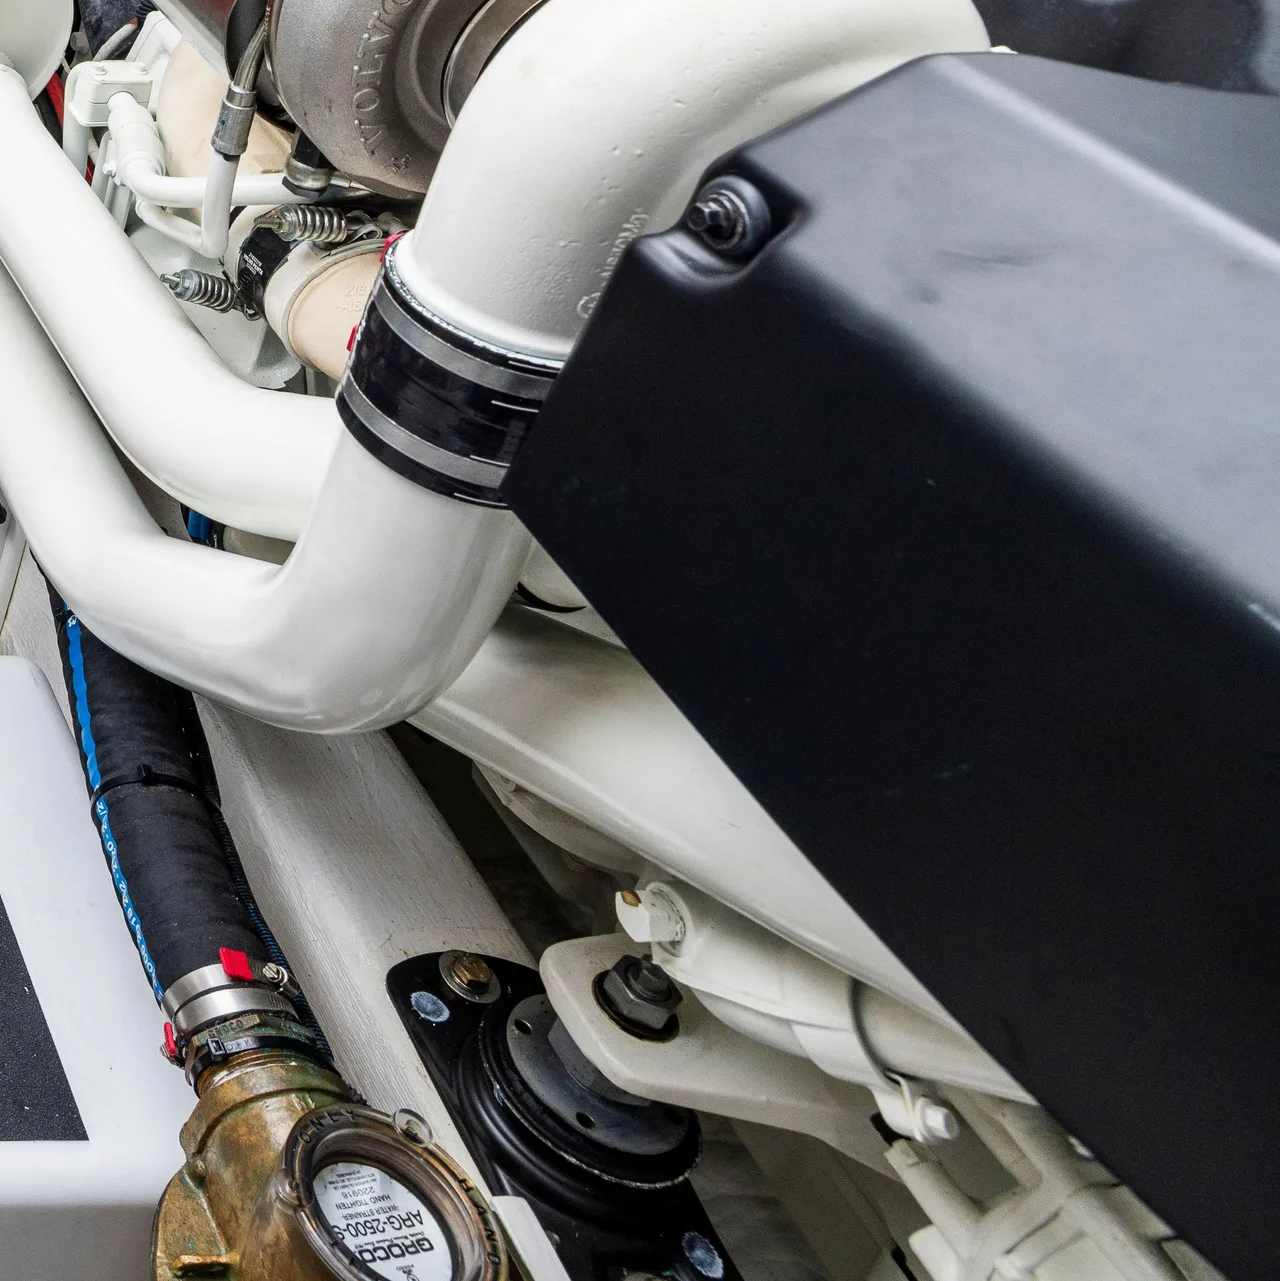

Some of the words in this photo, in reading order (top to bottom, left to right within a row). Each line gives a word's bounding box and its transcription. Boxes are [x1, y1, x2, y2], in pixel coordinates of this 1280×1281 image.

[335, 1198, 367, 1210] TIGHTEN
[370, 1194, 391, 1204] HAND
[331, 1210, 423, 1240] ARG-2500-S
[361, 1237, 434, 1262] GROCO
